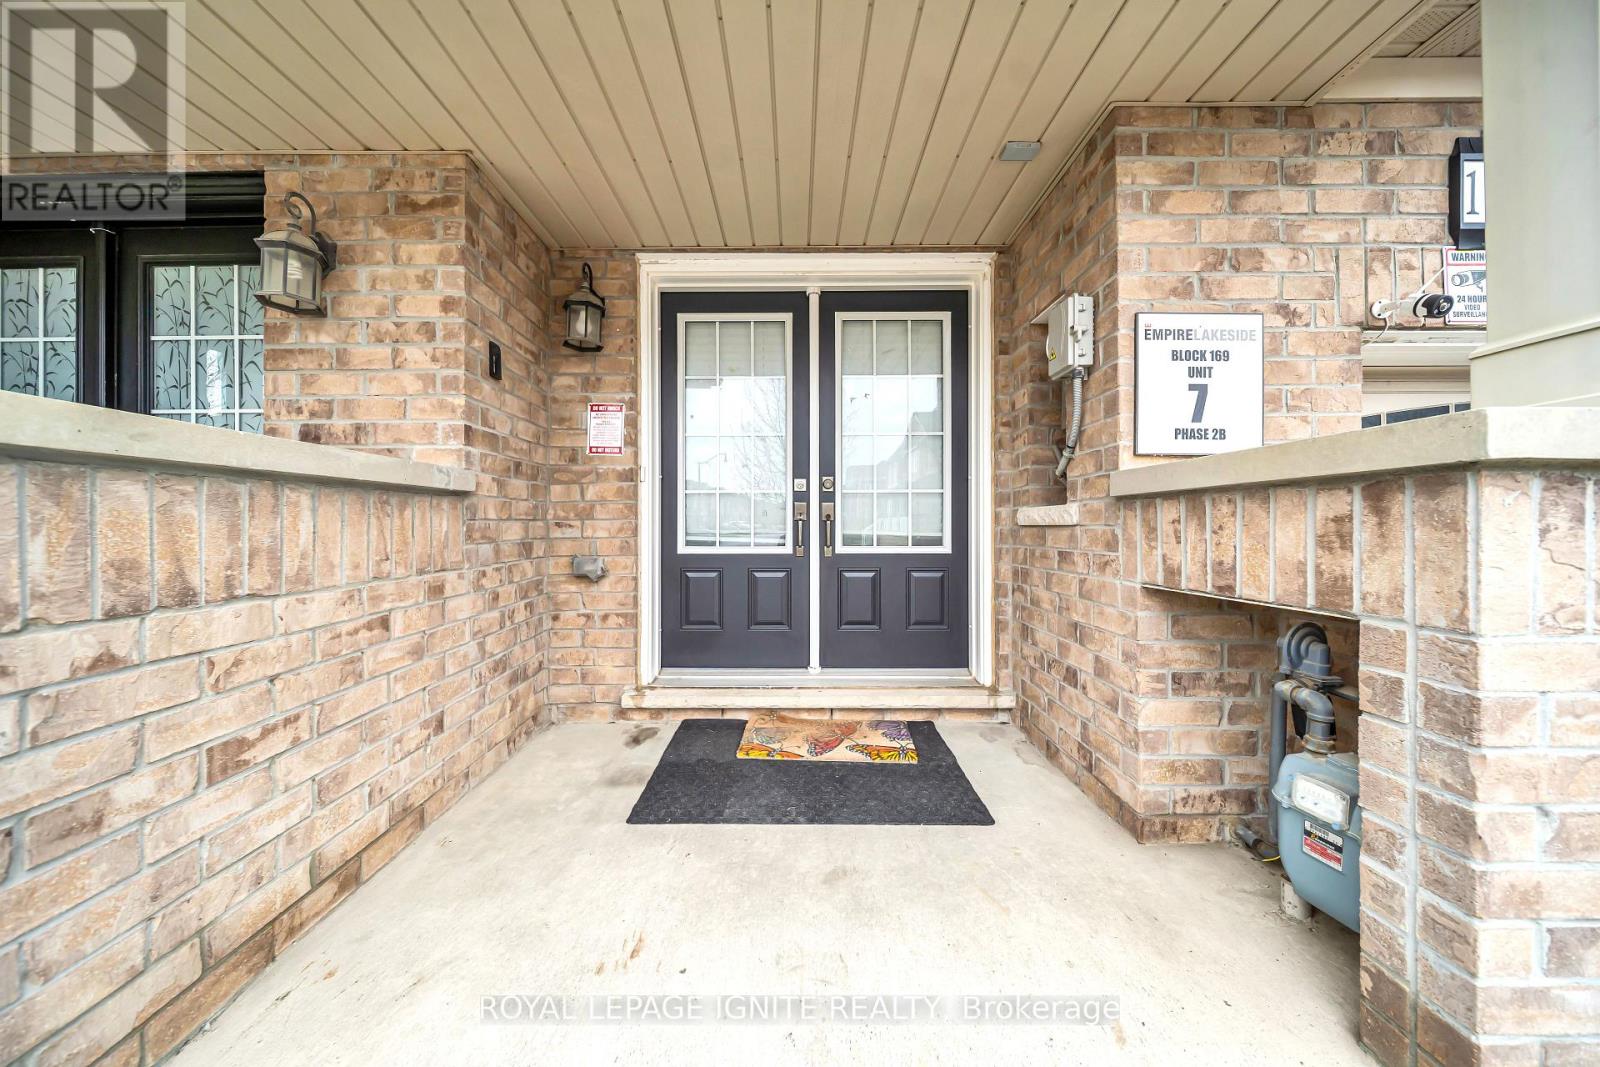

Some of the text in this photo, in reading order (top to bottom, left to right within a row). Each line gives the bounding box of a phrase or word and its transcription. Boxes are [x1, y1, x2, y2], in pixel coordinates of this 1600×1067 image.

[1451, 251, 1487, 262] WARNIN
[1457, 294, 1466, 303] 24
[1171, 349, 1230, 362] BLOCK 169
[1187, 366, 1214, 378] UNIT
[1188, 383, 1209, 423] 7
[1174, 427, 1227, 440] PHASE 2B
